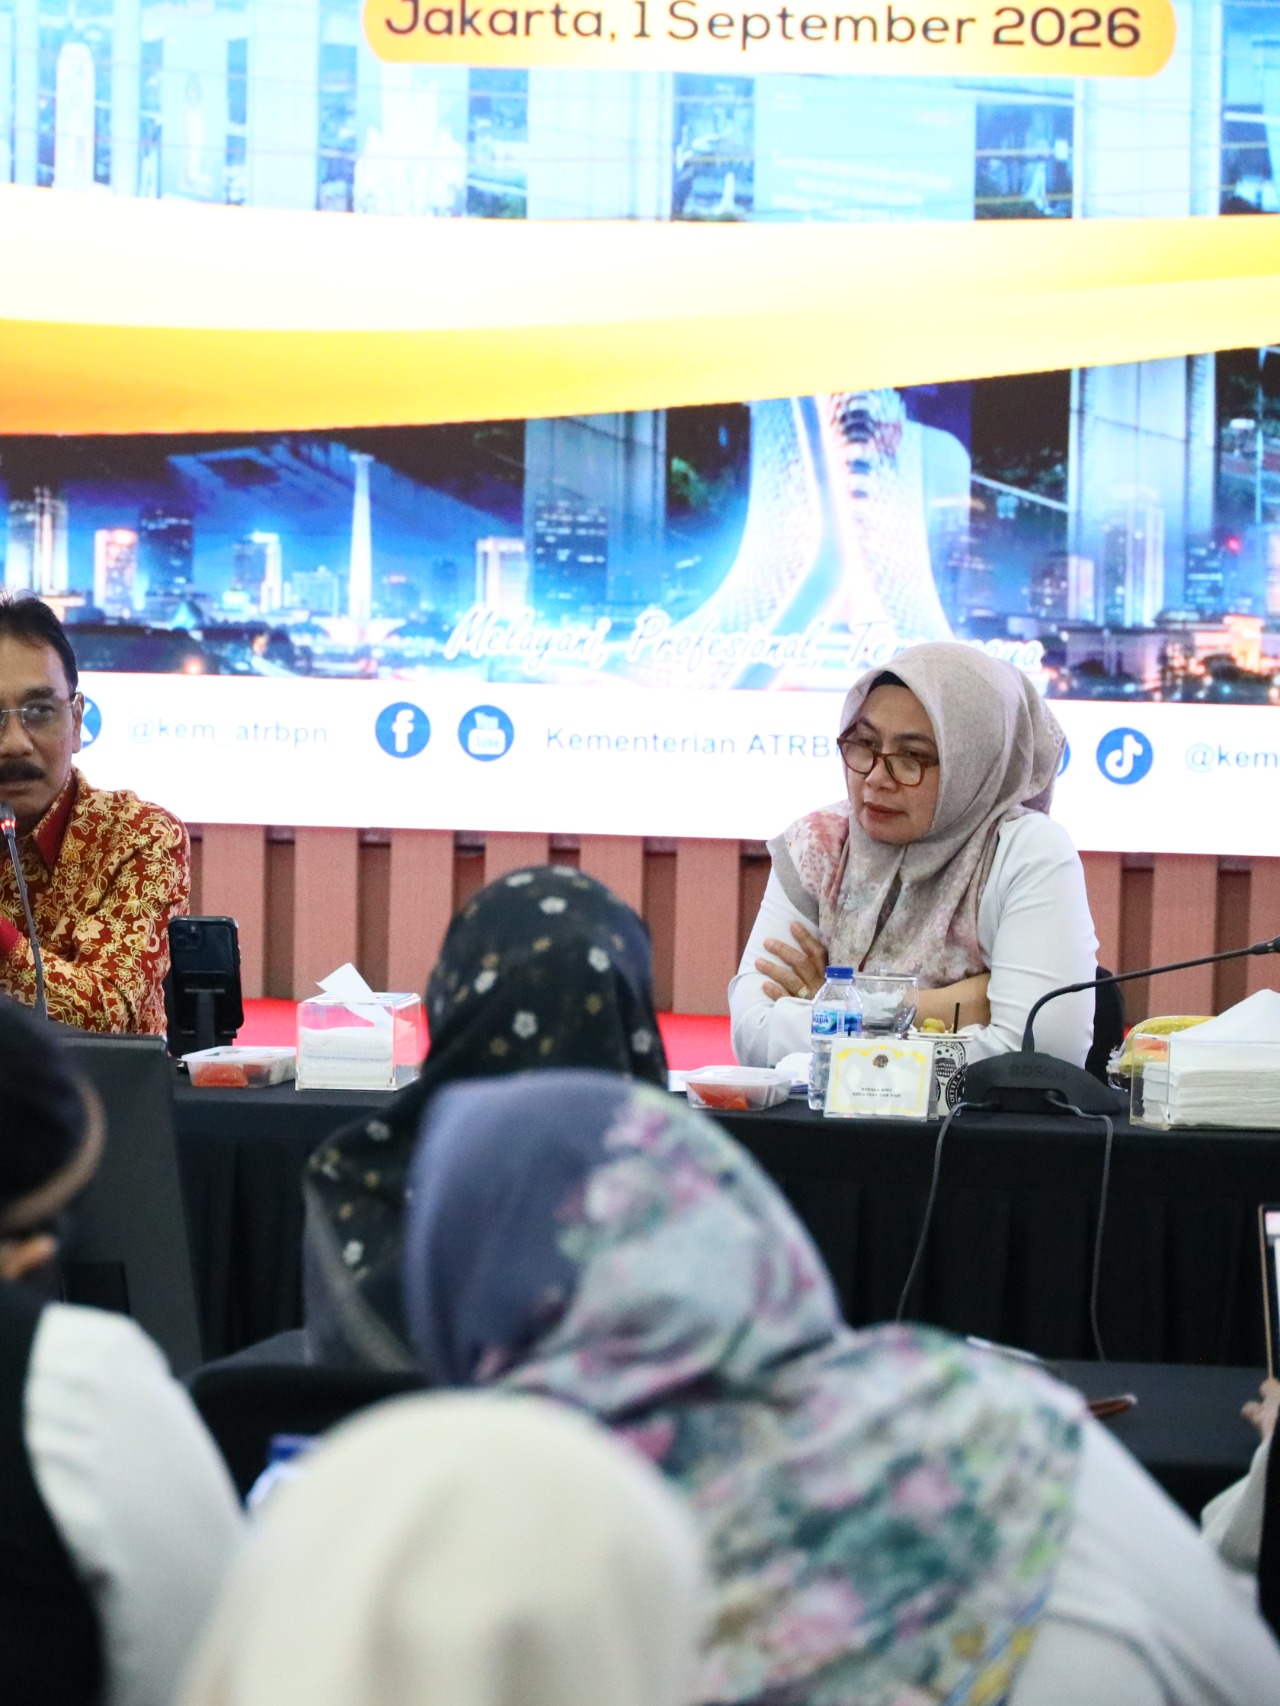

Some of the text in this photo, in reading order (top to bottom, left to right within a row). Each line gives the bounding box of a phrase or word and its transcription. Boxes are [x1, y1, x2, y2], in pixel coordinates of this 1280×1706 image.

[385, 0, 1140, 51] Jakarta, 1 September 2026
[546, 727, 841, 758] Kementerian ATRB
